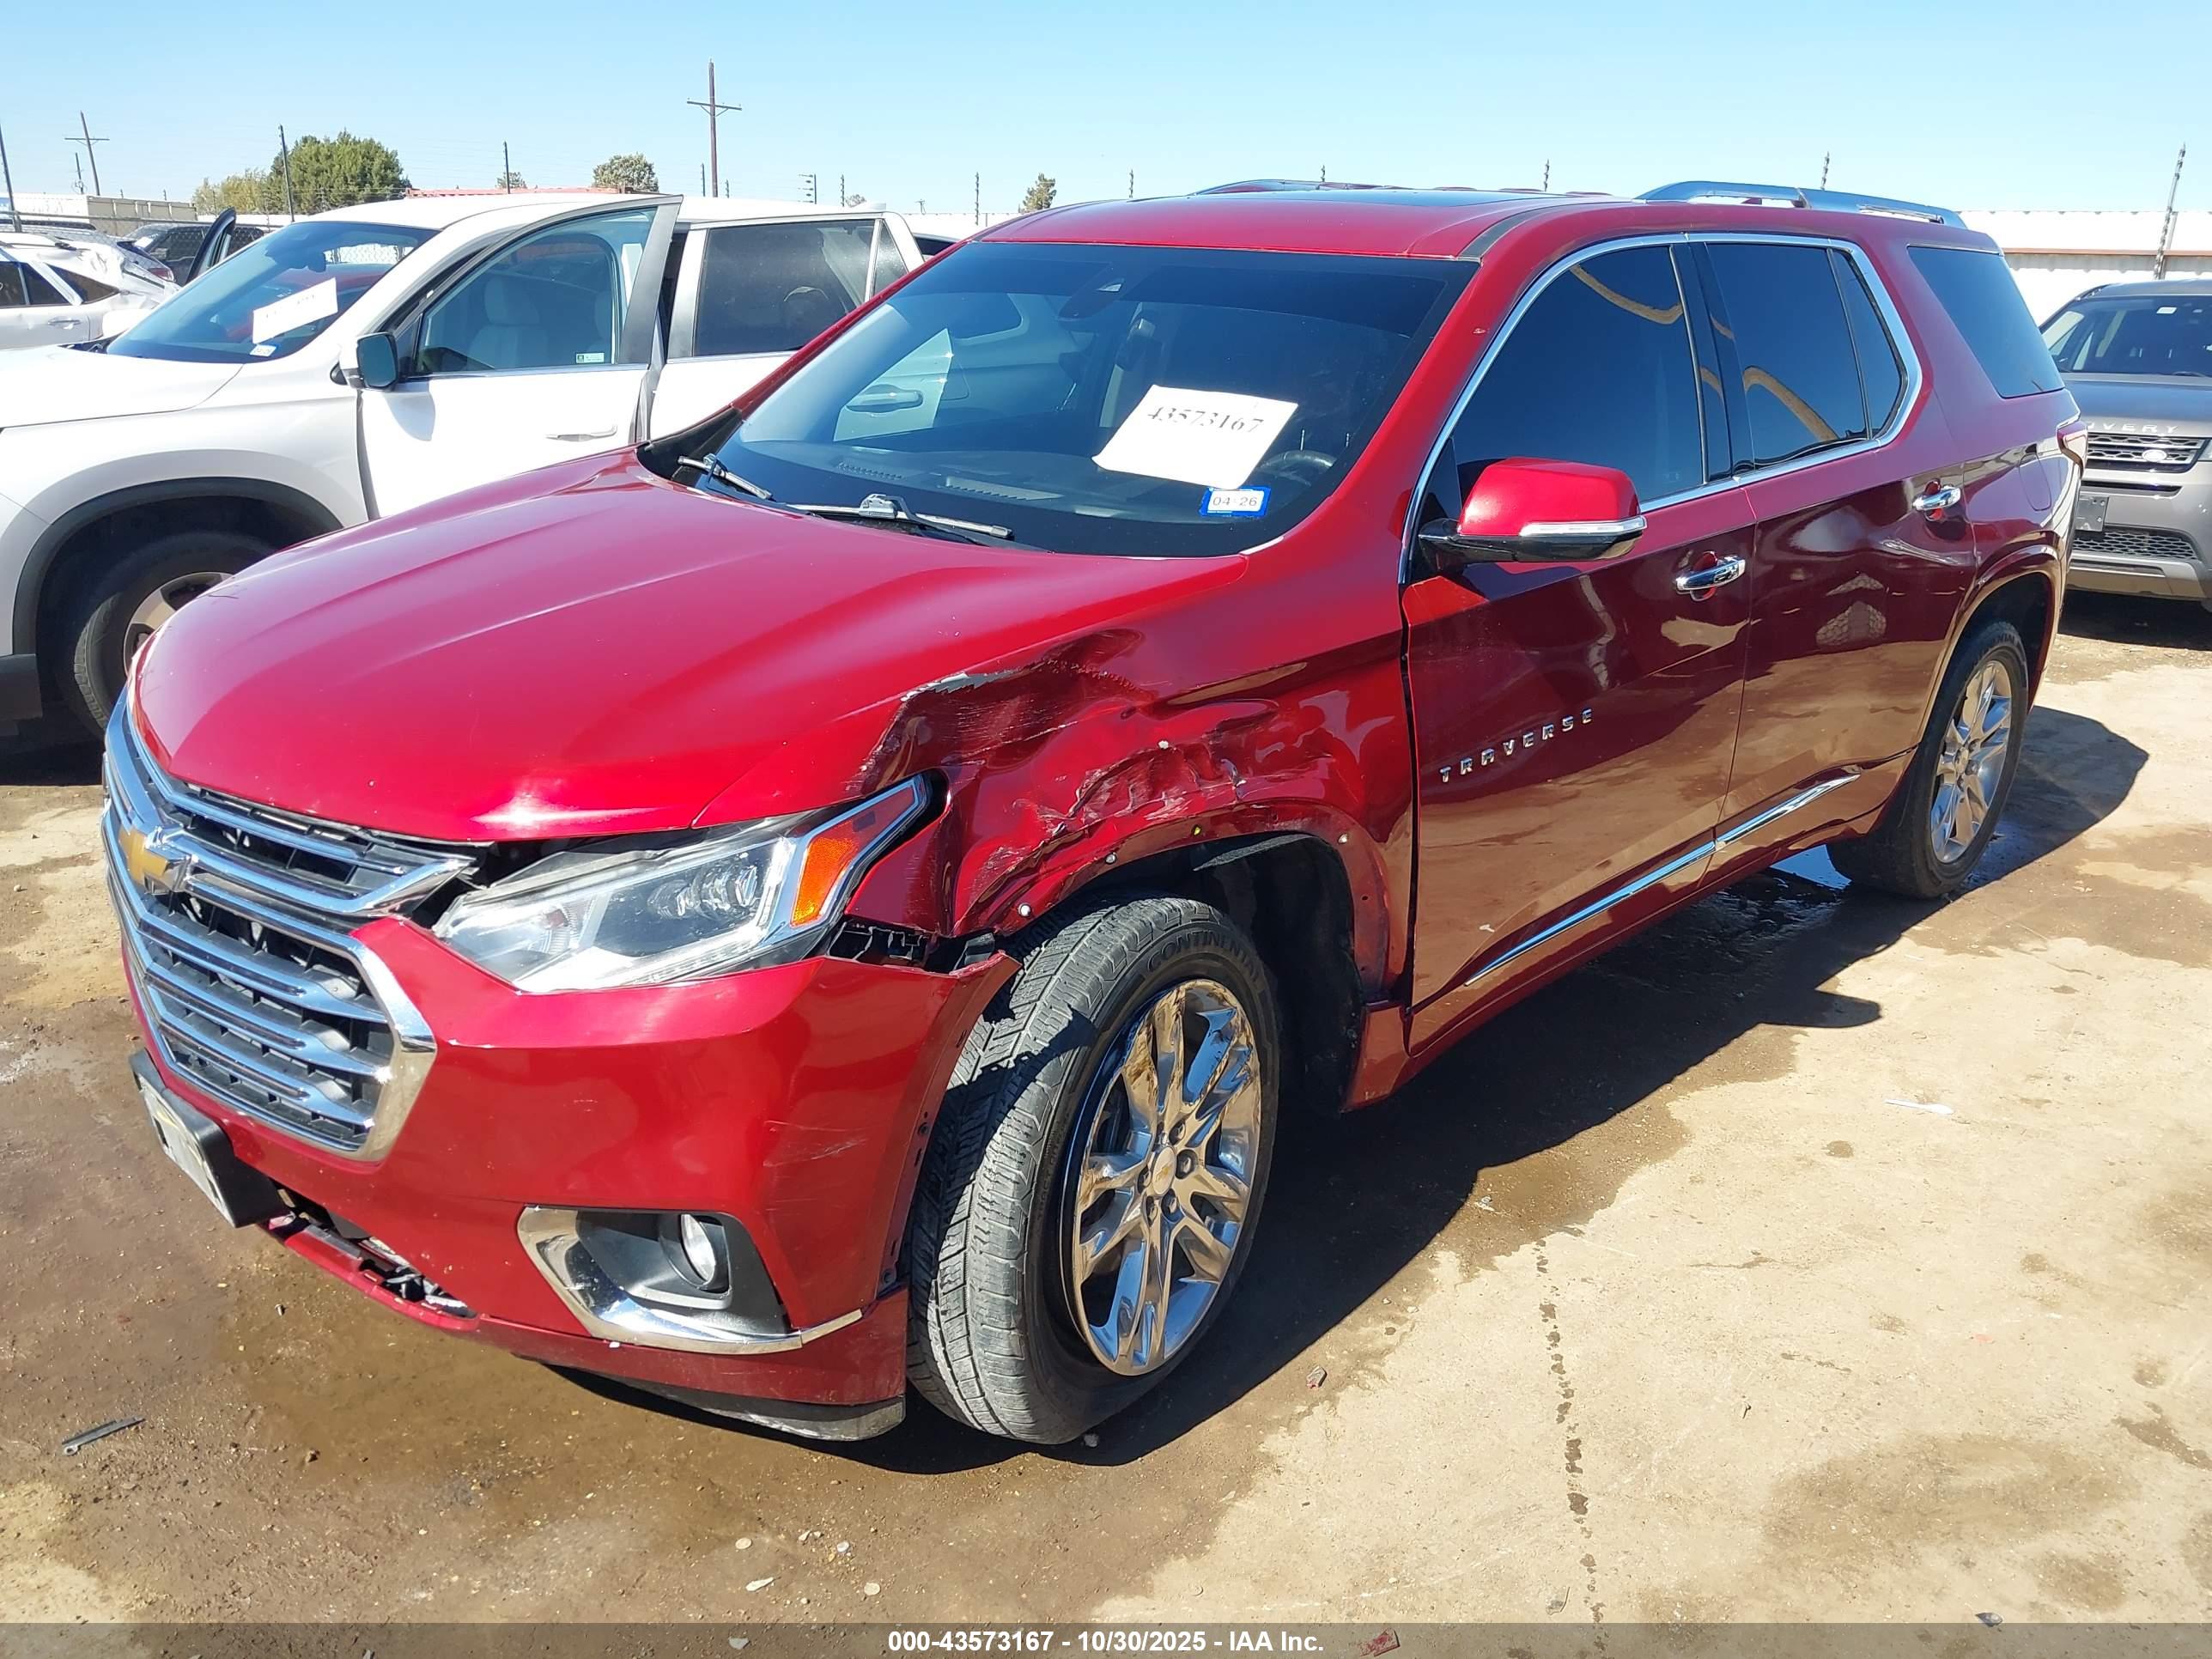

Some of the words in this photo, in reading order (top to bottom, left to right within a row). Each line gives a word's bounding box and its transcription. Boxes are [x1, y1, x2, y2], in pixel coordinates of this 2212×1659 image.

[1148, 406, 1264, 432] 43573167
[1440, 708, 1593, 782] TRAVERSE
[1147, 930, 1259, 983] CONTINENTAL
